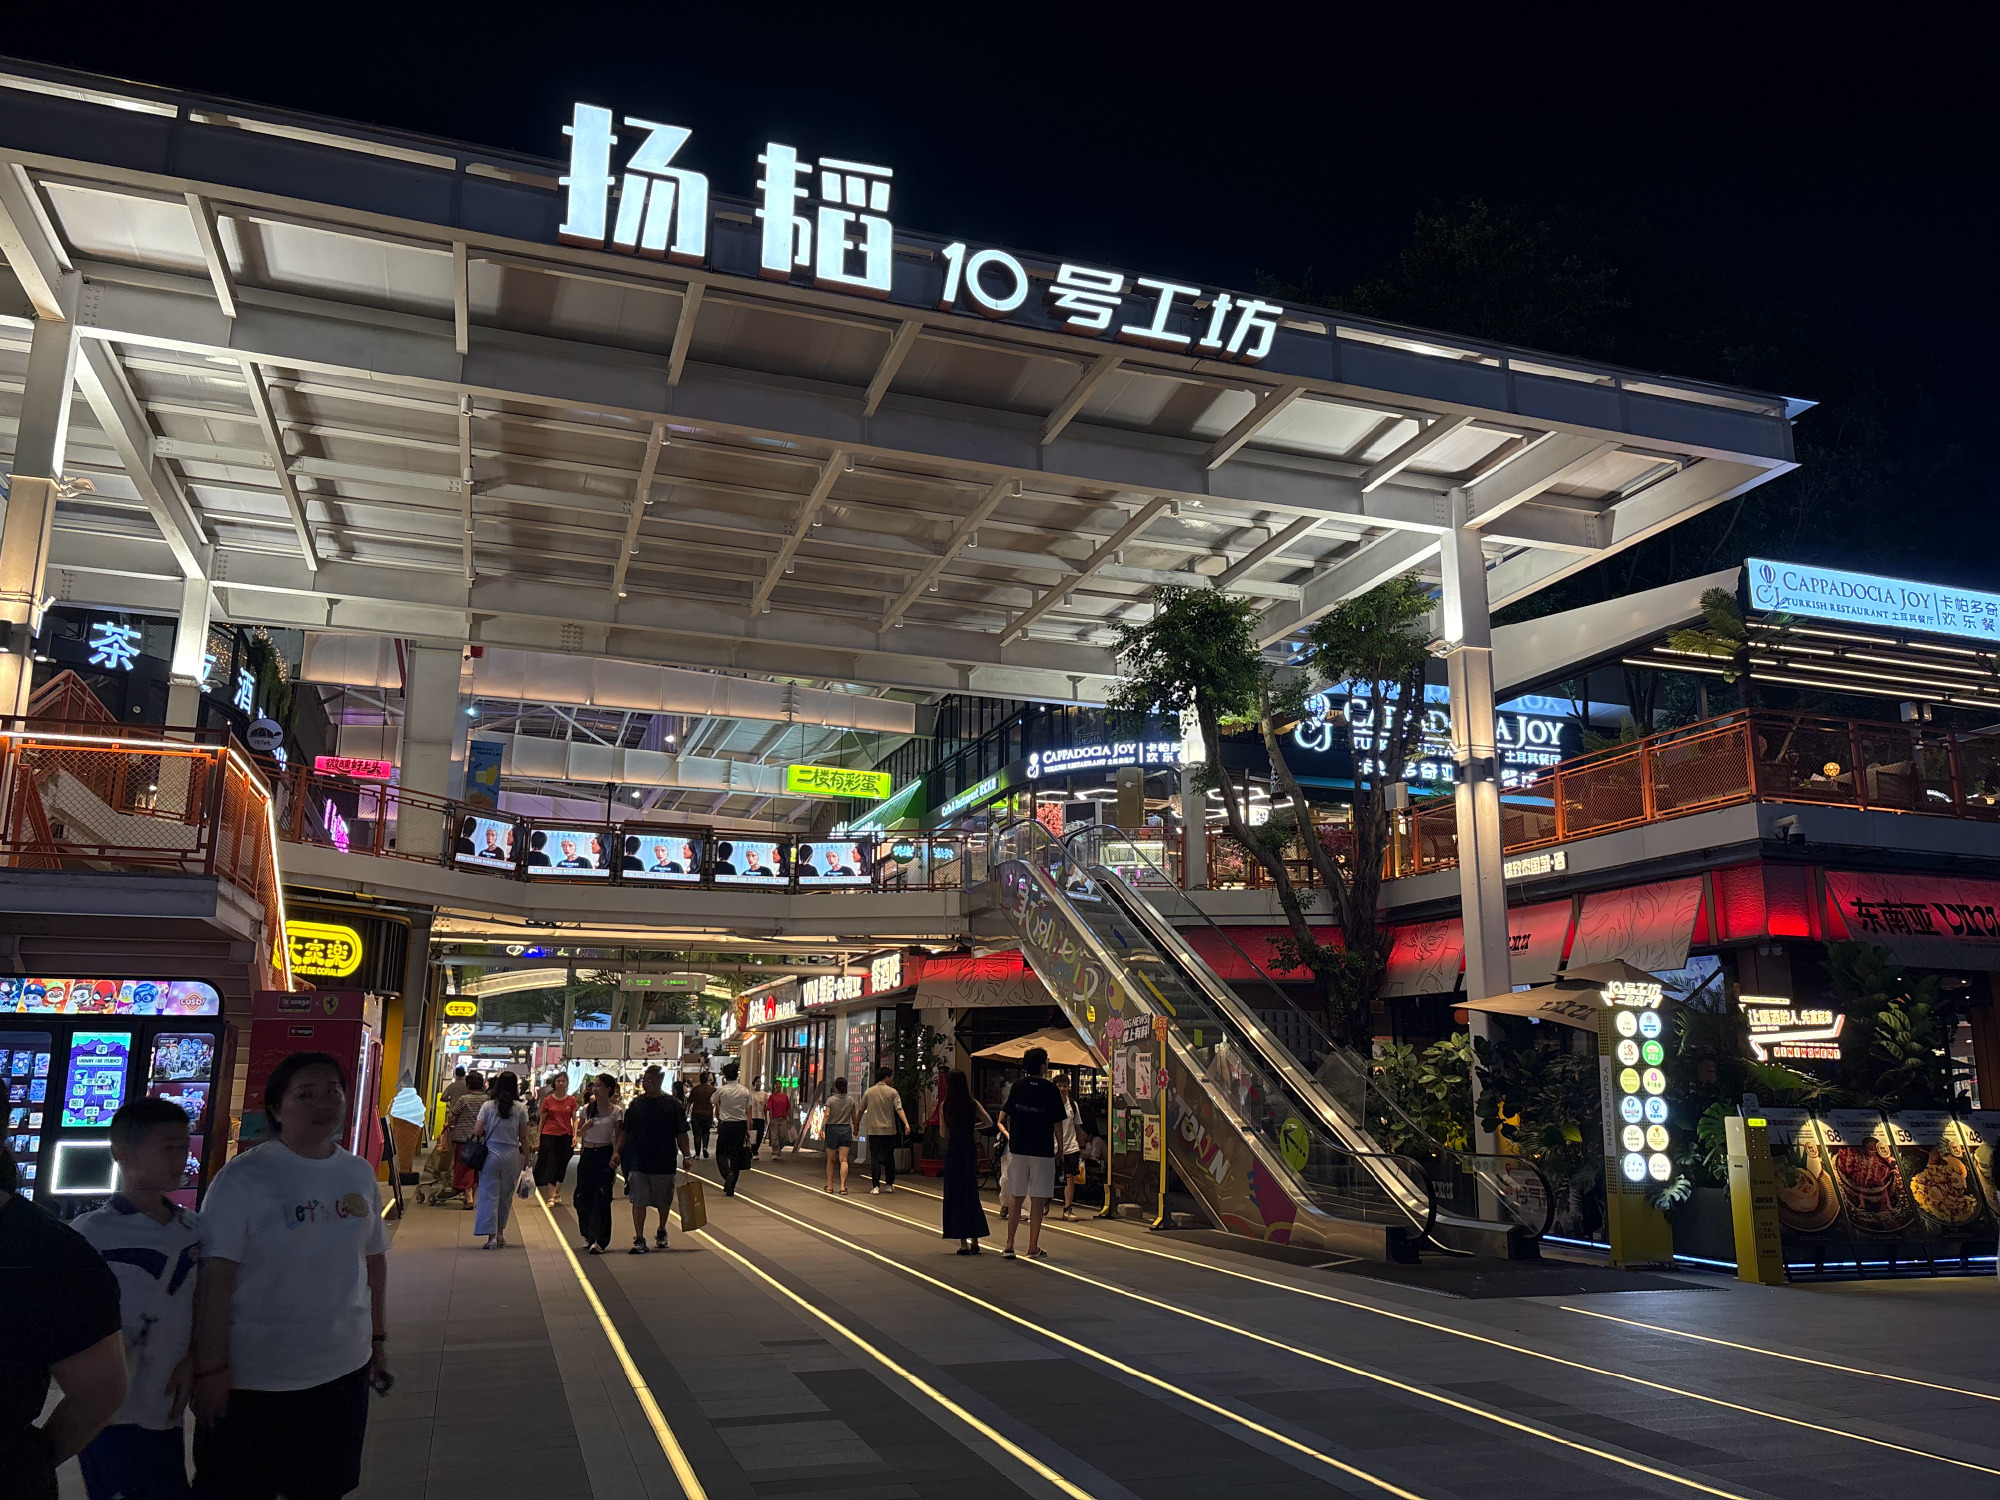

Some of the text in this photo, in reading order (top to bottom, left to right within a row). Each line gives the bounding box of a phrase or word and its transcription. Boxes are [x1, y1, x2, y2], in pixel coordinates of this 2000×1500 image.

[1782, 571, 1931, 610] CAPPADOCIA JOY
[1785, 597, 1935, 625] TURKISH RESTAURANT 土耳其餐厅
[1941, 612, 1996, 632] 欢乐餐
[88, 621, 142, 671] 茶
[1515, 715, 1564, 748] JOY
[1043, 742, 1137, 764] CAPPADOCIA JOY
[797, 769, 880, 795] 二楼有彩蛋
[1850, 896, 1941, 936] 东南亚
[1607, 980, 1662, 997] 10号工坊
[1155, 1016, 1168, 1029] SEE
[1602, 1066, 1614, 1147] YOUNG TOWN
